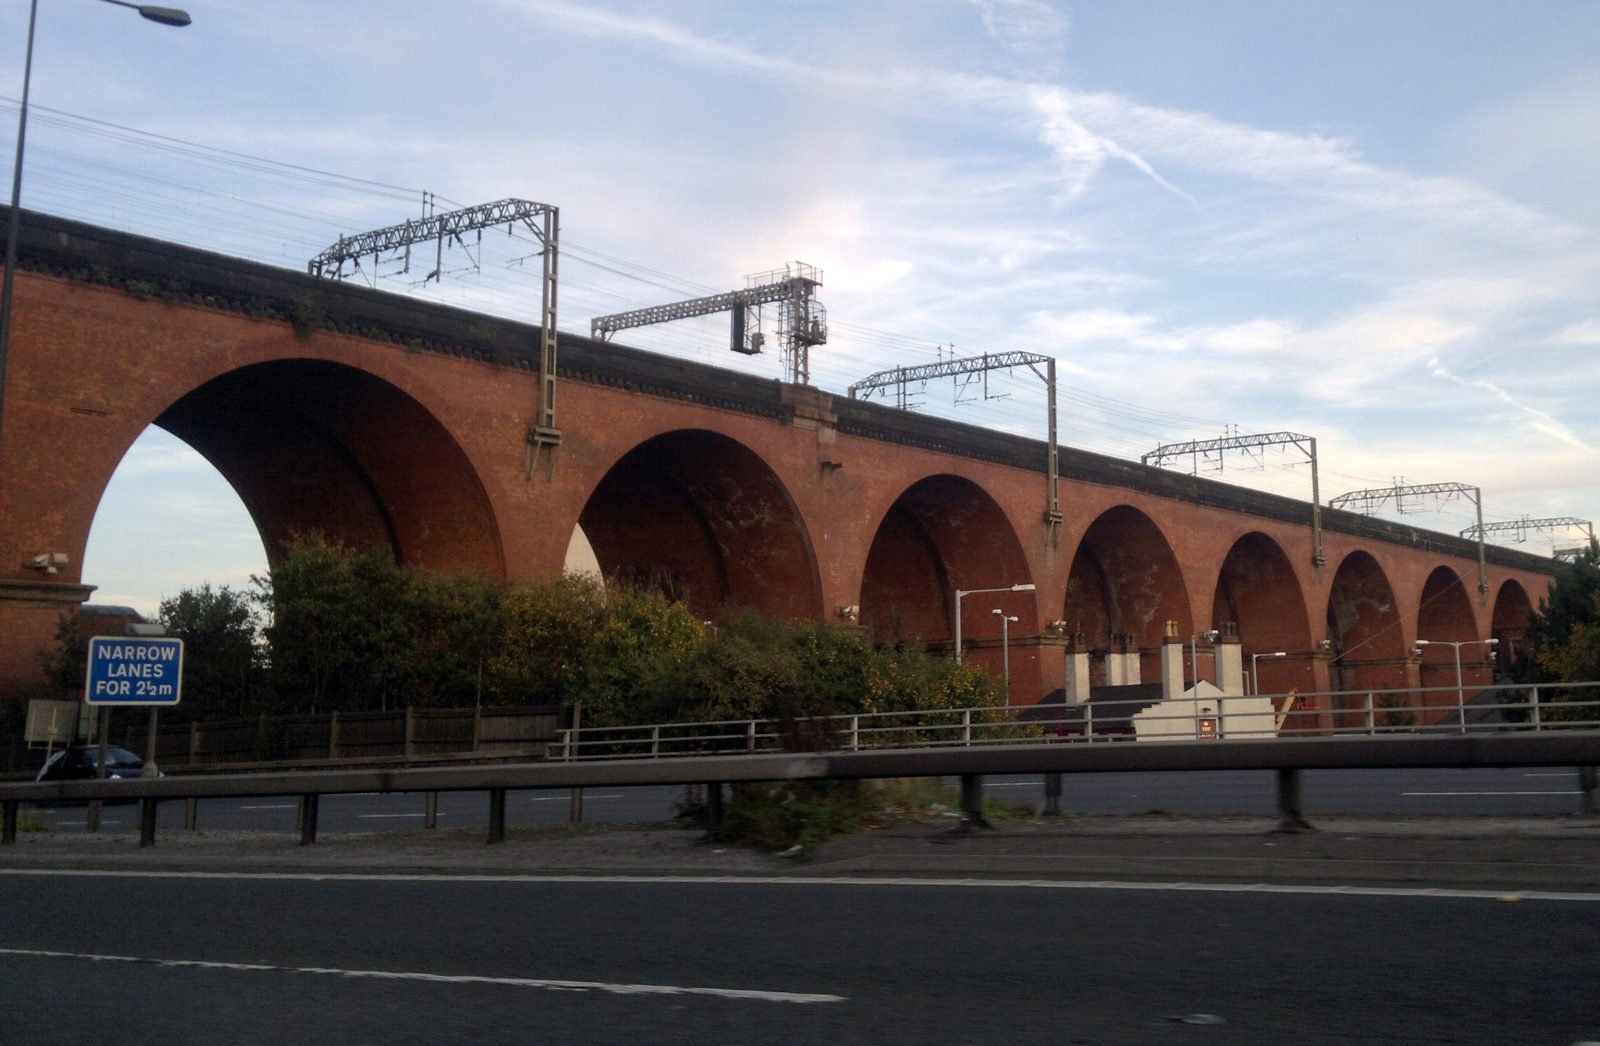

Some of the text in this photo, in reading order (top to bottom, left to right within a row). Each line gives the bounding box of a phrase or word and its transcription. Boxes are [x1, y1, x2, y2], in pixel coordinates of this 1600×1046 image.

[98, 645, 175, 660] NARROW
[107, 663, 164, 678] LANES
[96, 680, 130, 695] FOR
